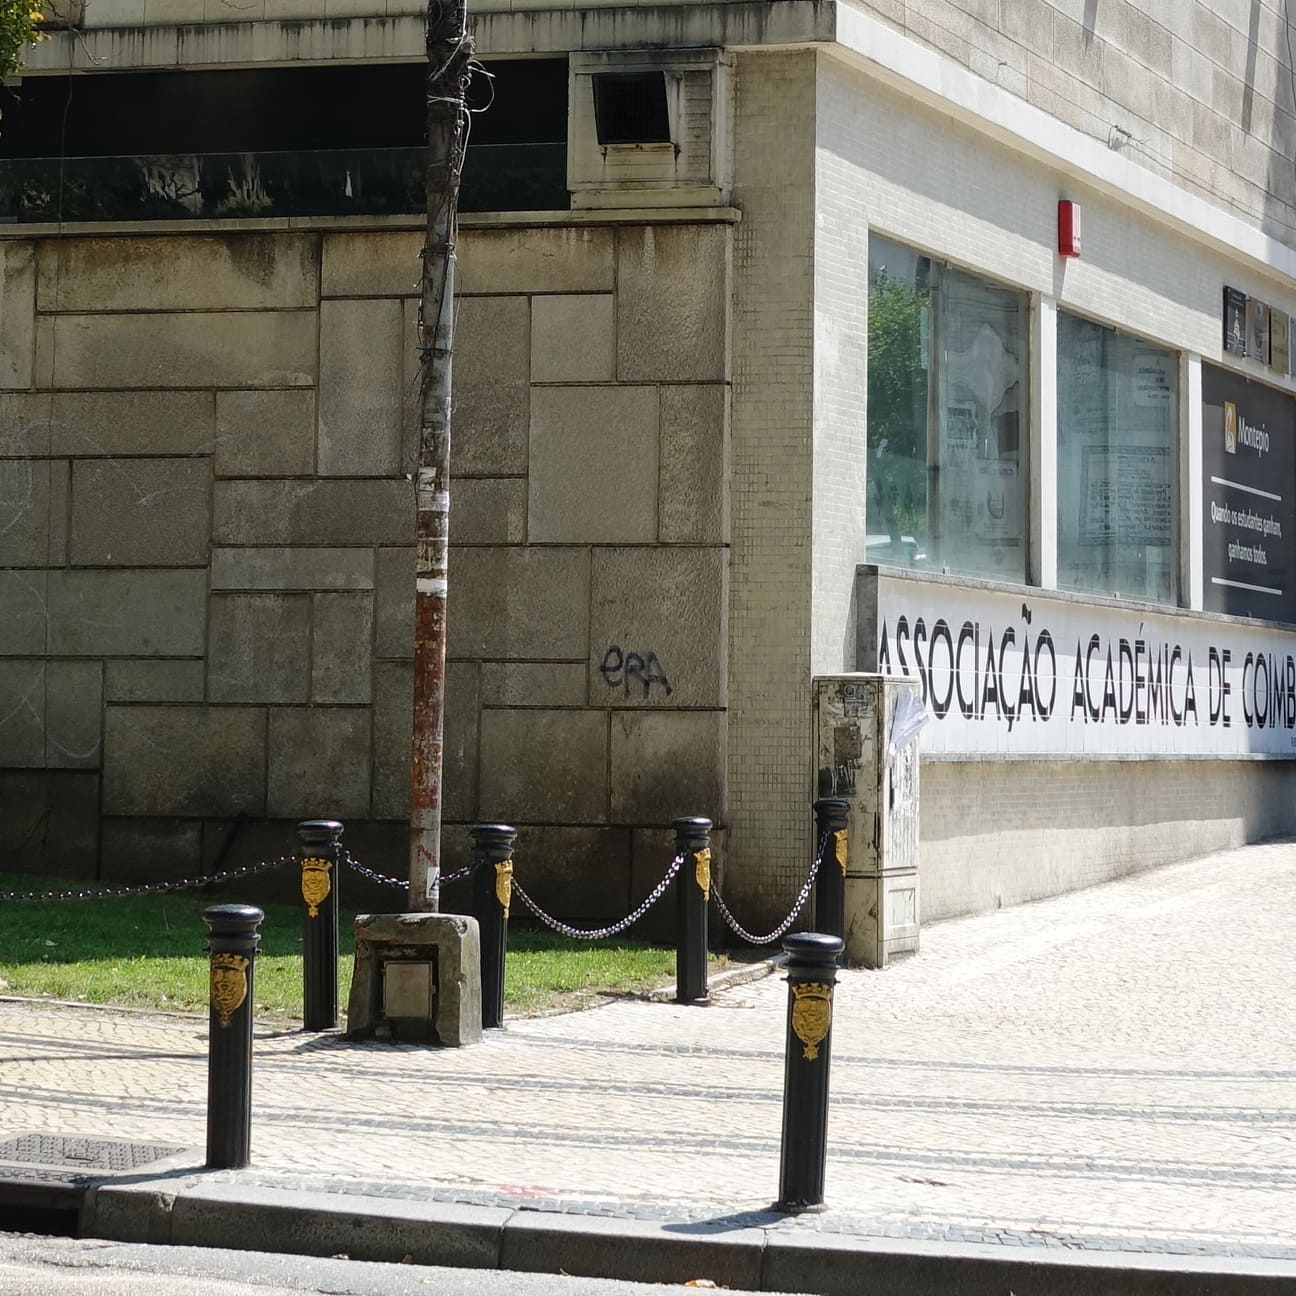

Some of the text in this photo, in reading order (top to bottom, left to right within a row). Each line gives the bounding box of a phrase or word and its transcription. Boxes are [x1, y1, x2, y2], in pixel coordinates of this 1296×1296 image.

[1238, 415, 1270, 458] Montepio
[1211, 500, 1231, 524] Quando
[1238, 508, 1263, 532] estudantes
[879, 603, 1057, 732] ASSOCIAÇÃO
[1071, 622, 1198, 726] ACADÉMICA
[1208, 646, 1232, 728] DE
